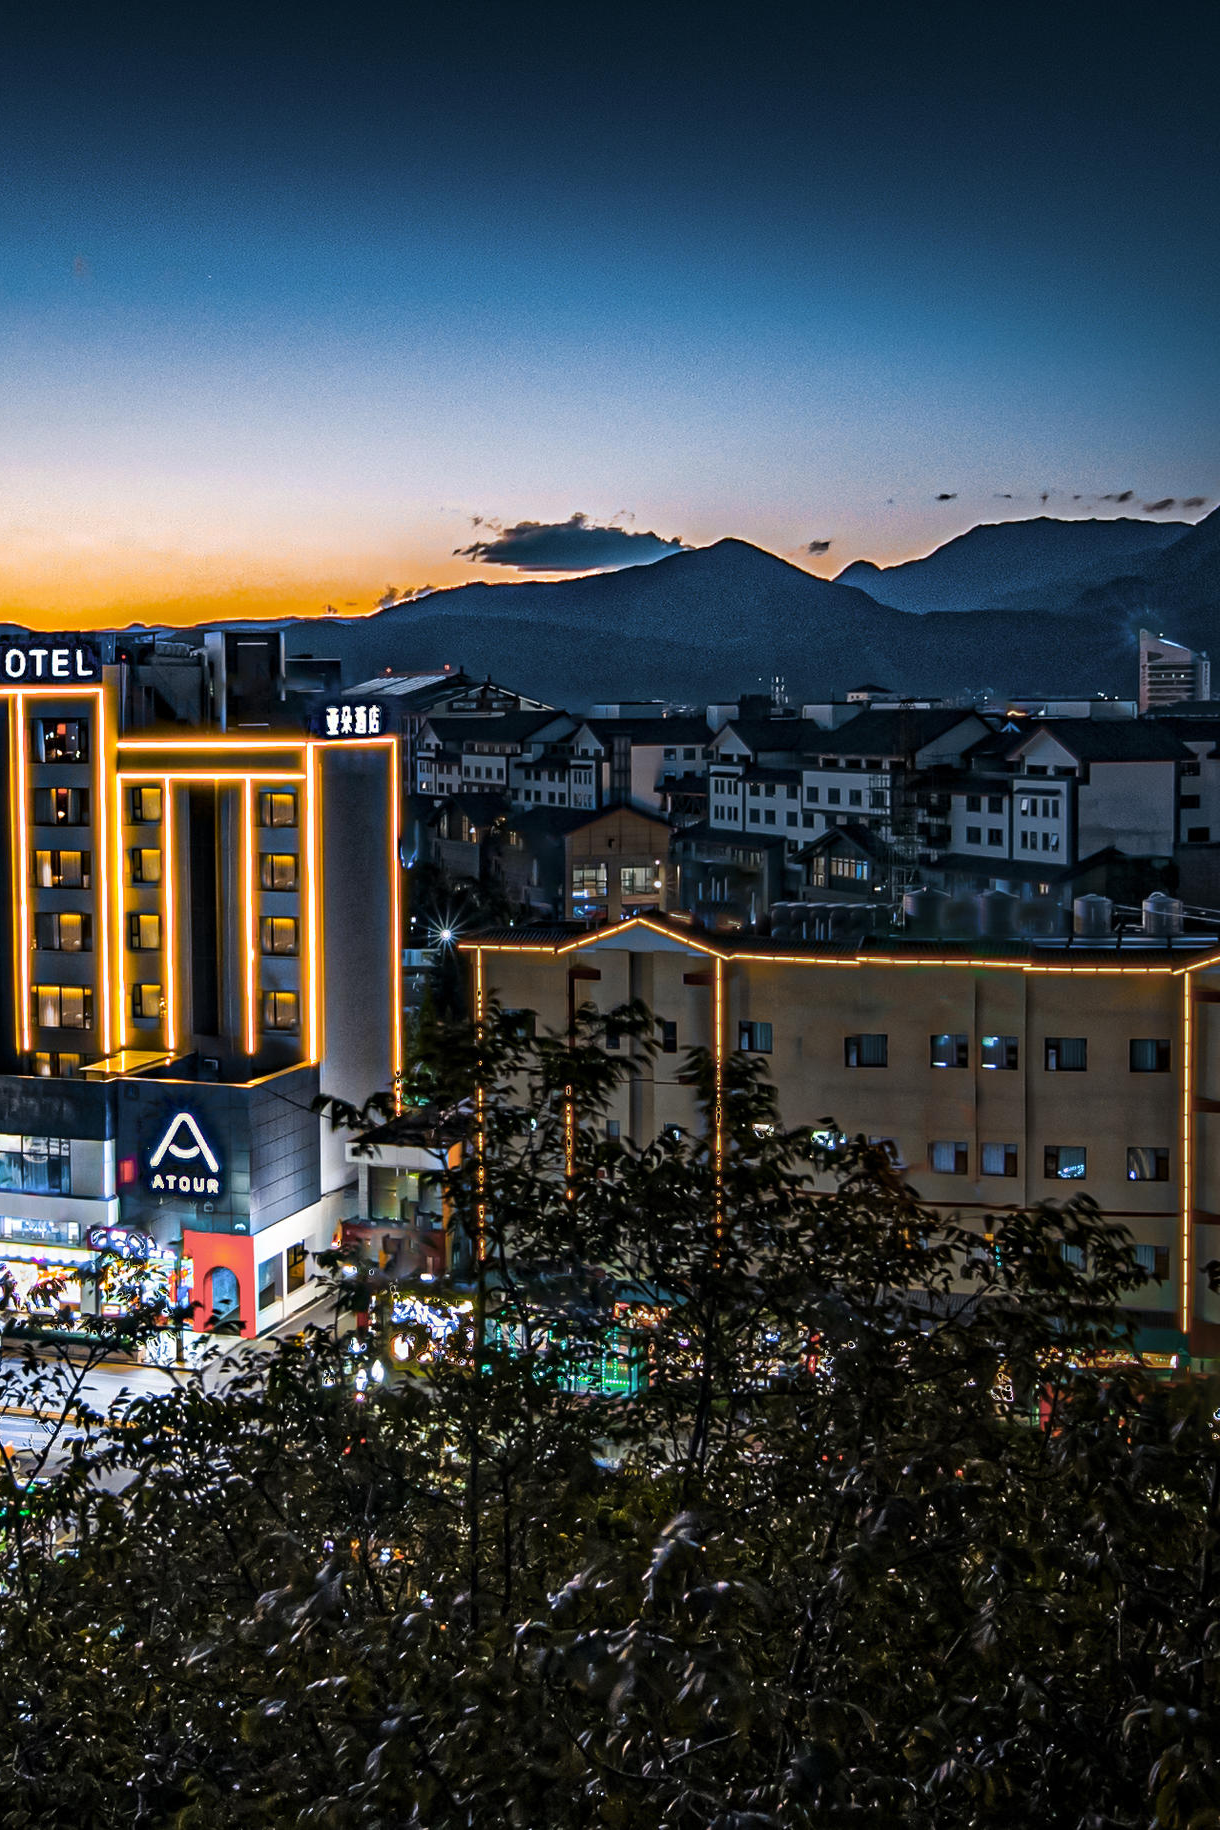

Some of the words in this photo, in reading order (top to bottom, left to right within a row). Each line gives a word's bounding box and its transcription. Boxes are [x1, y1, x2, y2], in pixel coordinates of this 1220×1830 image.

[326, 705, 380, 735] 亚朵酒店
[152, 1174, 219, 1194] ATOUR
